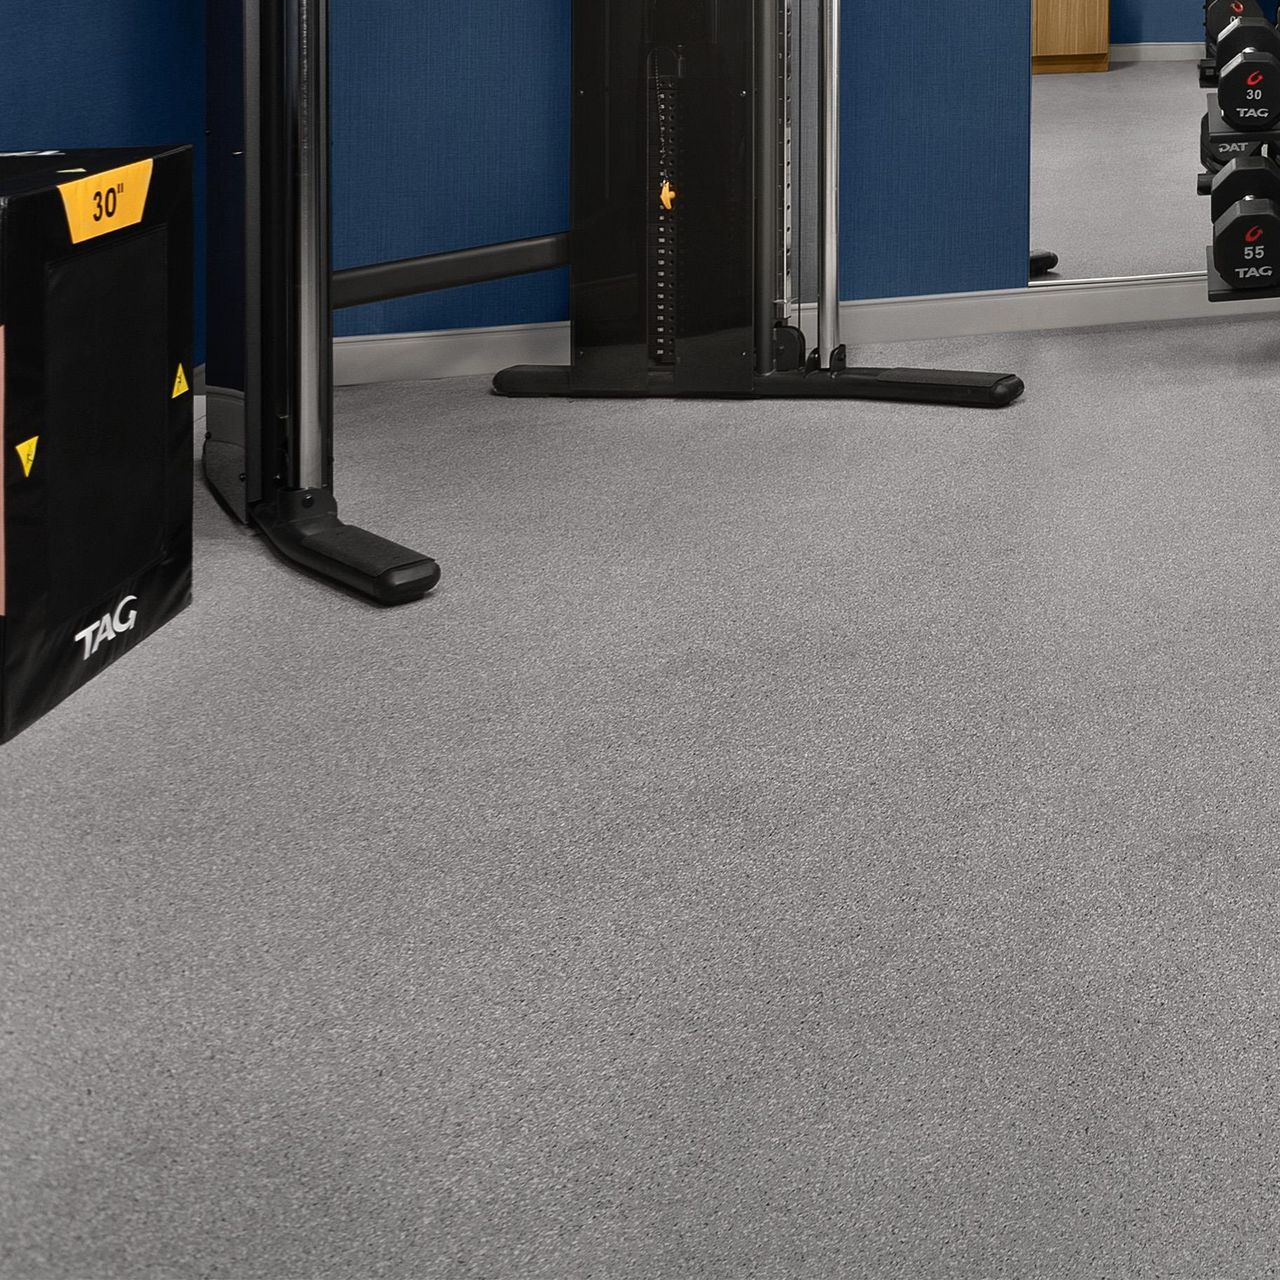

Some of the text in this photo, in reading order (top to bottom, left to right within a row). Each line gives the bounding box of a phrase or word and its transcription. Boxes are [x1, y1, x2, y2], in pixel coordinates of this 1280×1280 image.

[1246, 89, 1262, 100] 30
[1236, 107, 1269, 118] TAG
[92, 182, 124, 222] 30"
[1244, 245, 1265, 260] 55
[1235, 265, 1273, 278] TAG
[74, 594, 138, 661] TAG
